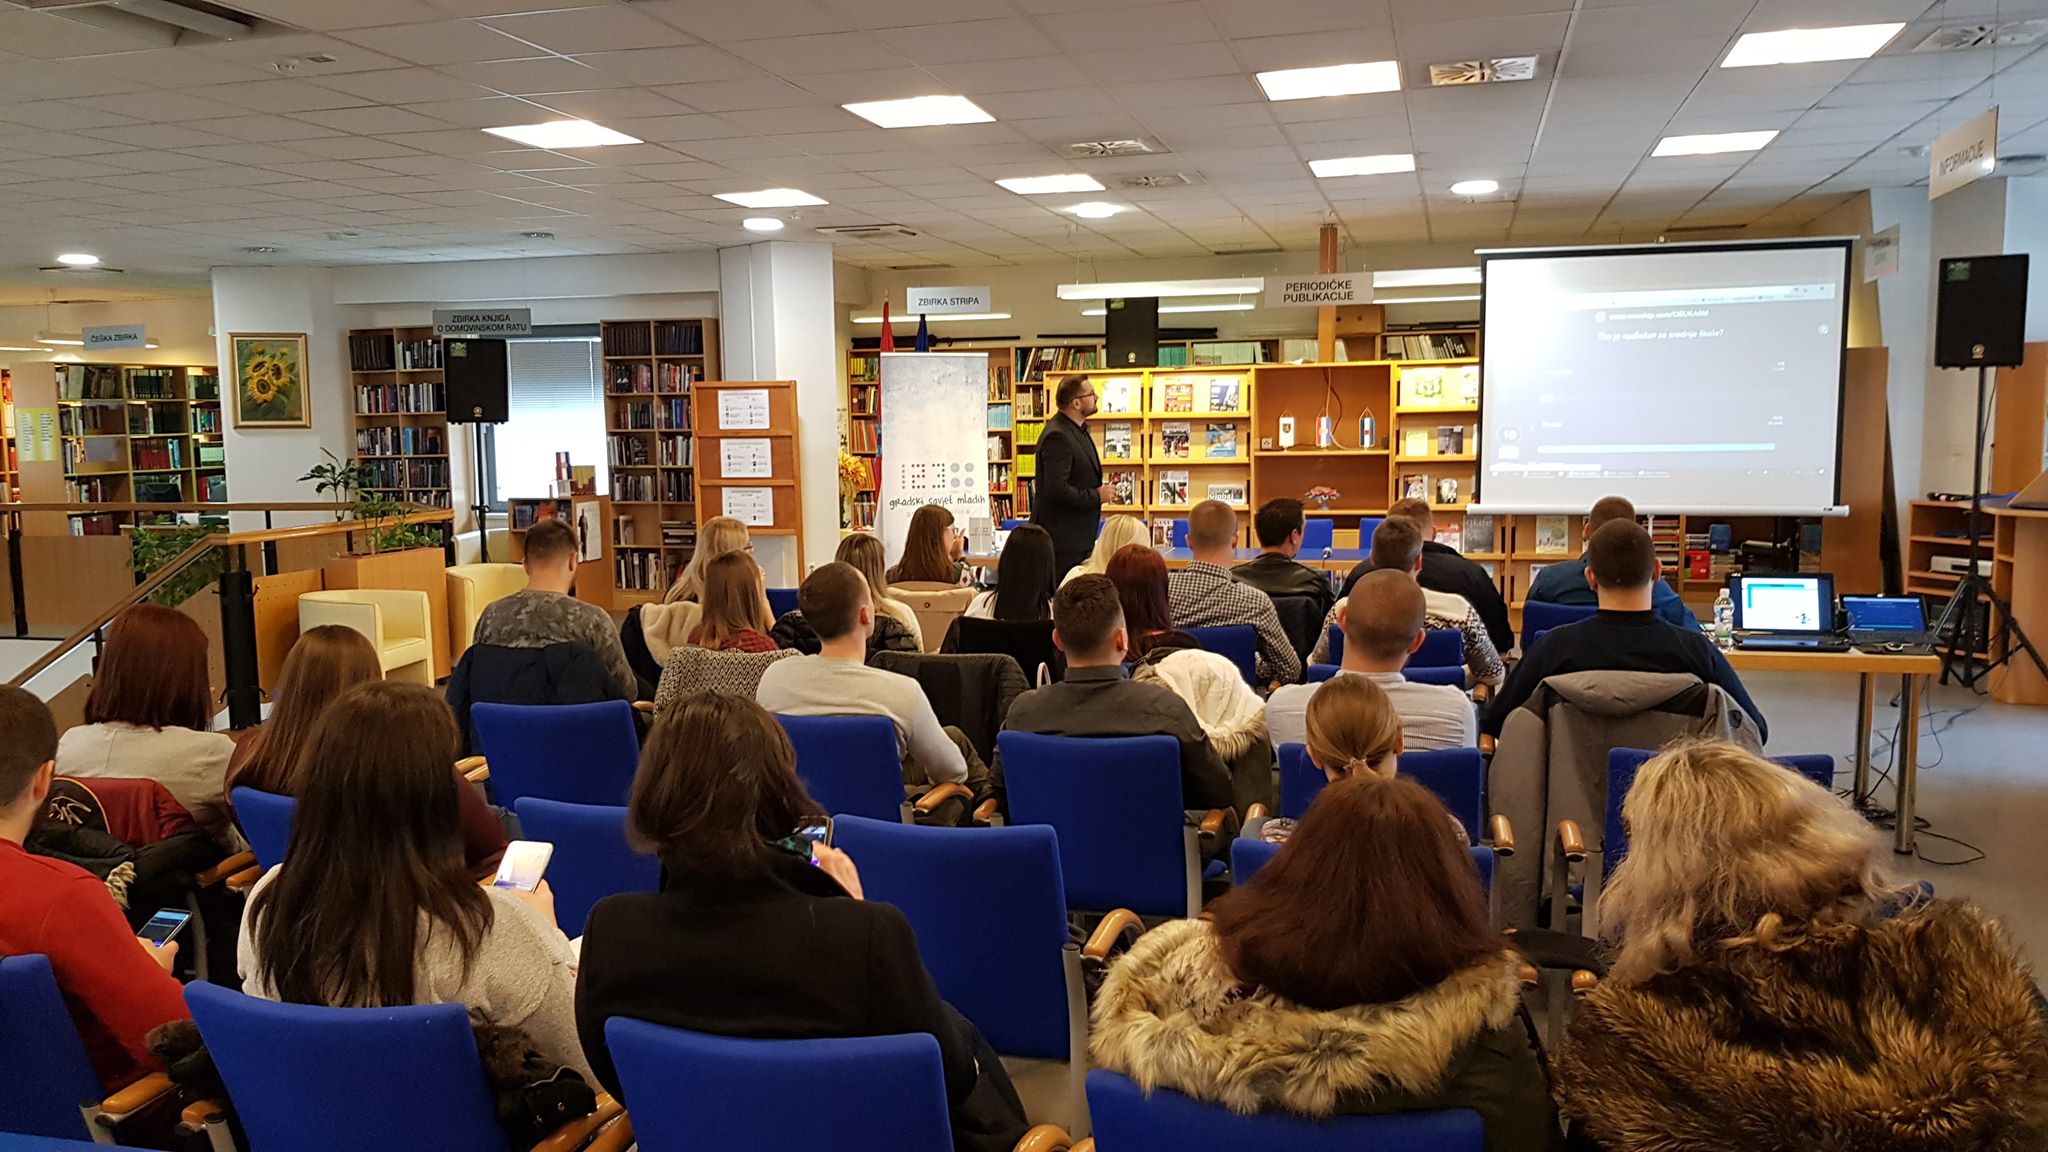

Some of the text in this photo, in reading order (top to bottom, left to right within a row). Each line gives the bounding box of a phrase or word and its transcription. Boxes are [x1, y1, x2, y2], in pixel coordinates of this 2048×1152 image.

[1939, 139, 1985, 176] INFORMACIJE
[1286, 279, 1352, 292] PERIODIČKE
[918, 296, 980, 306] ZBIRKA STRIPA
[1283, 291, 1354, 303] PUBLIKACIJE
[452, 314, 511, 323] ZBIRKA KNJIGA
[437, 323, 527, 333] O DOMOVINSKOM RATU
[91, 332, 138, 342] ČEŠKA ZBIRKA
[889, 493, 985, 510] gradski savjet mladih
